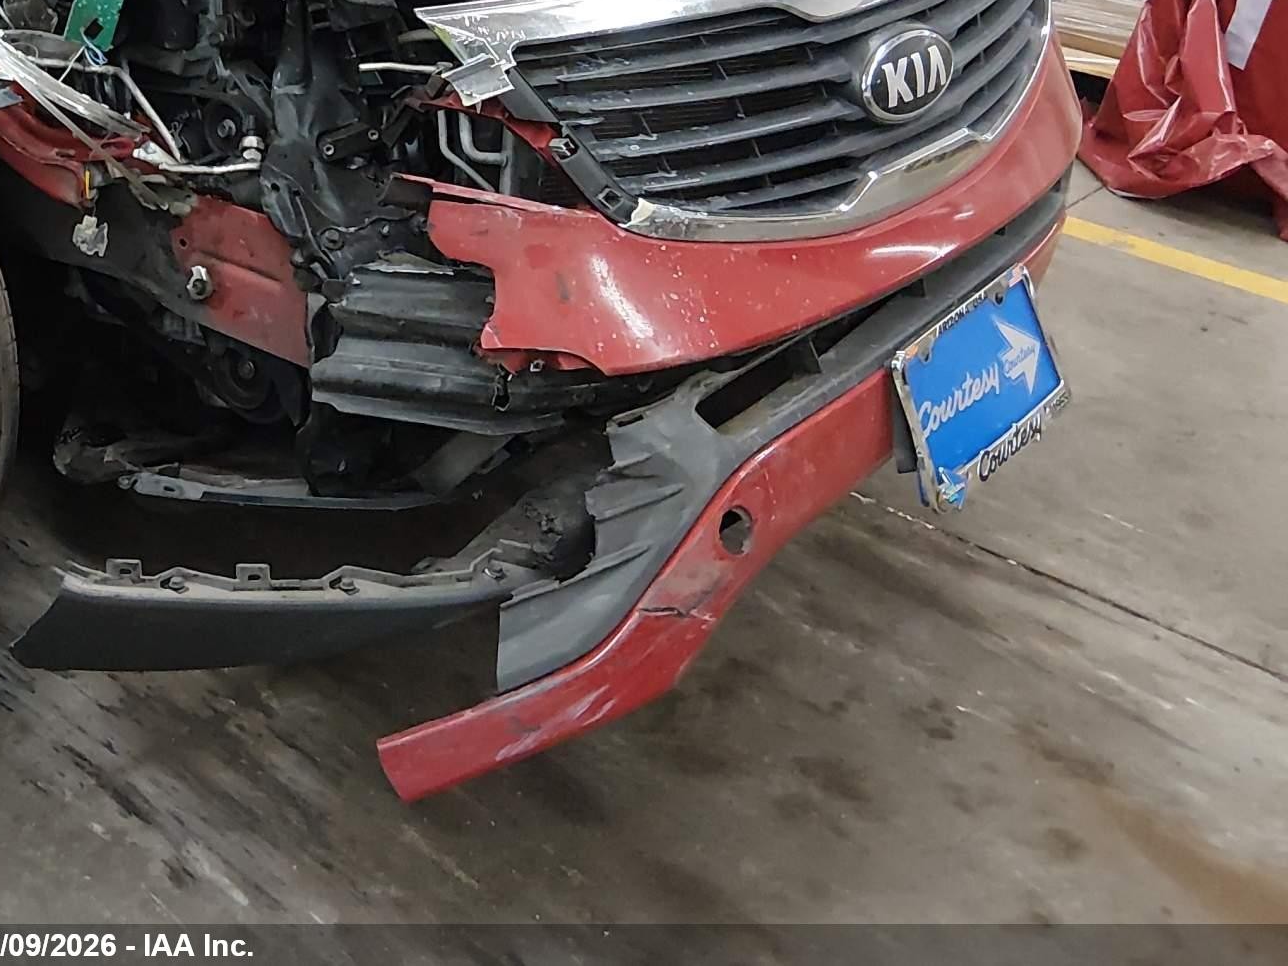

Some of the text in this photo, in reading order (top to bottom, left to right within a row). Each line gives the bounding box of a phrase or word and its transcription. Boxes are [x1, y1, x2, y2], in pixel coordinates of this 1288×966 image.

[881, 45, 947, 108] KIA
[918, 362, 1000, 440] Courtesy
[977, 413, 1042, 482] Courtesy
